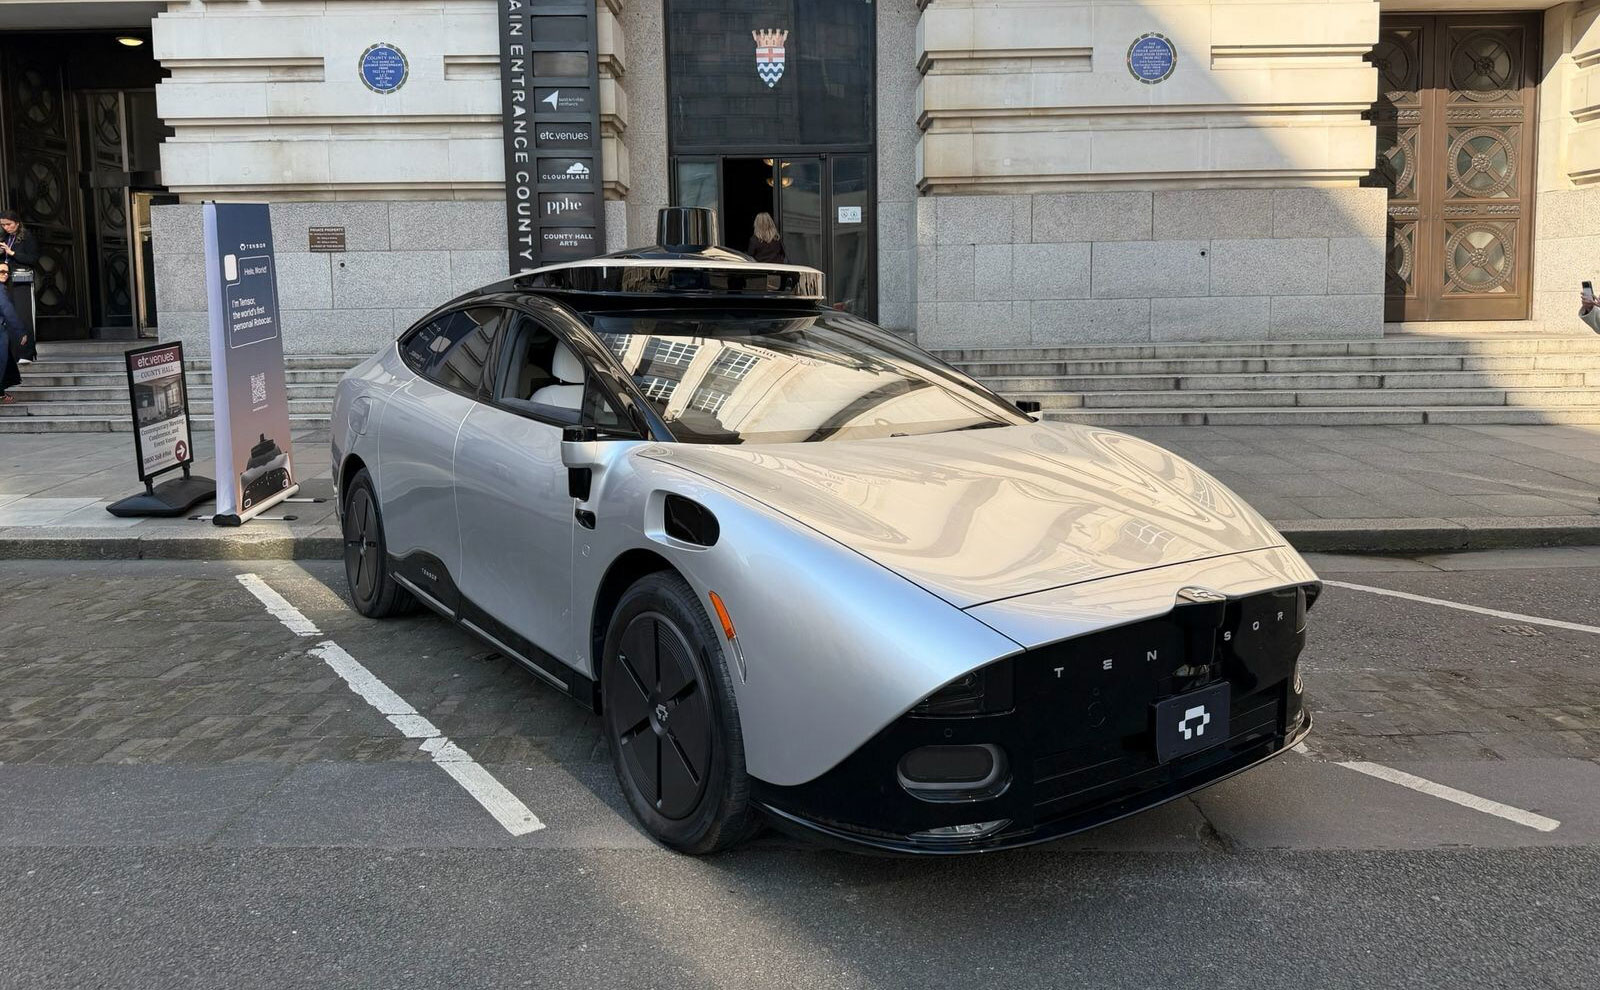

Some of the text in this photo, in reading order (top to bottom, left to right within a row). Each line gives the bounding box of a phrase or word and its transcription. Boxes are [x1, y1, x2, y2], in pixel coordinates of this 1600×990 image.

[510, 44, 529, 163] ENTRANCE
[540, 131, 588, 140] etc.venues
[547, 197, 582, 214] pphe
[515, 171, 533, 261] COUNTY
[232, 311, 242, 320] the
[256, 306, 265, 314] first
[234, 320, 254, 332] personal
[138, 352, 174, 368] etc.venues
[140, 365, 174, 379] COUNTY HALL
[1053, 611, 1284, 678] TENSOR
